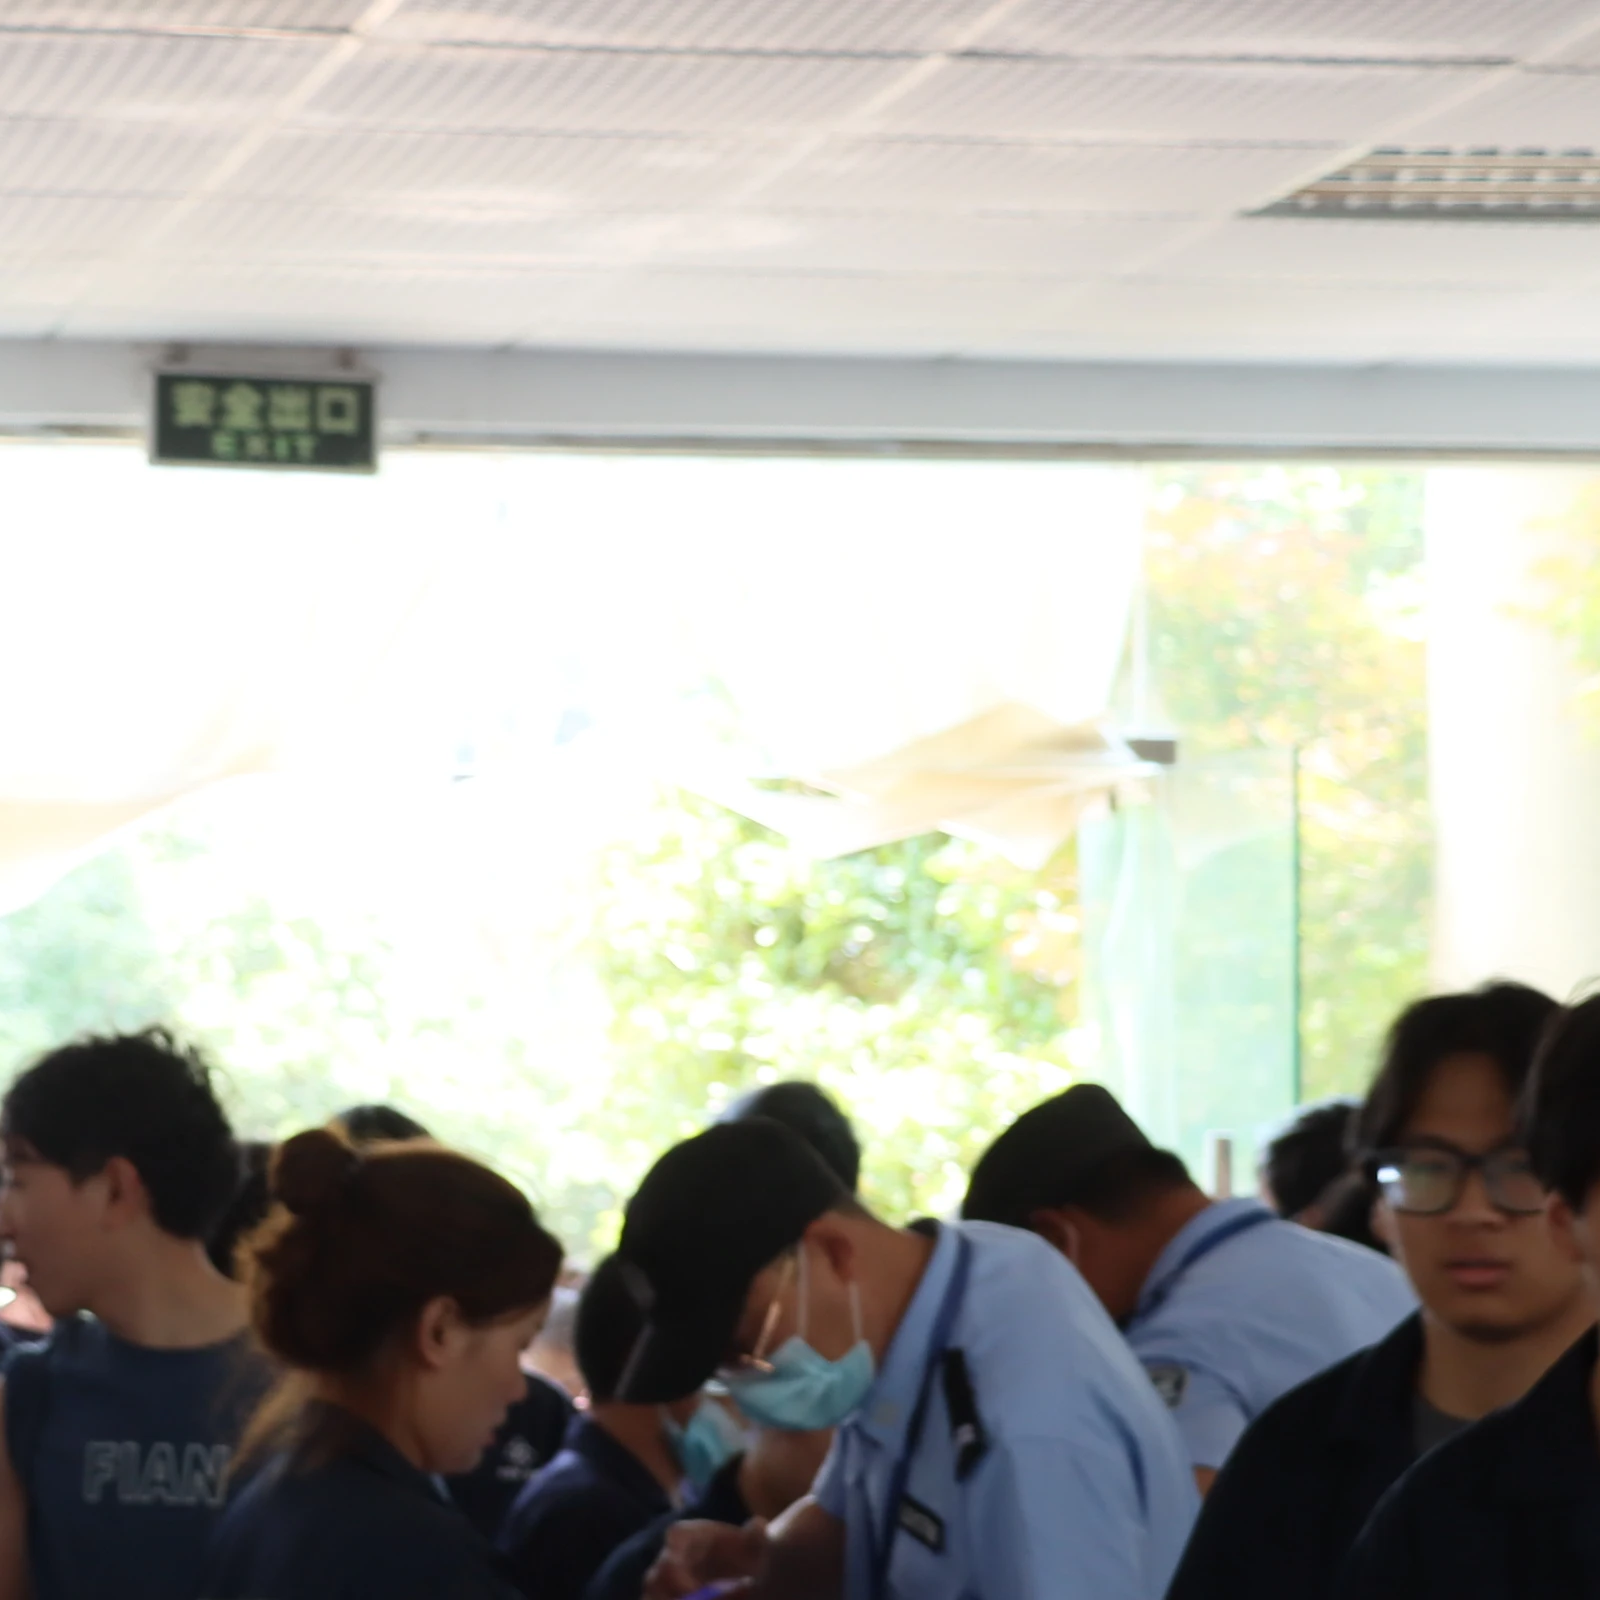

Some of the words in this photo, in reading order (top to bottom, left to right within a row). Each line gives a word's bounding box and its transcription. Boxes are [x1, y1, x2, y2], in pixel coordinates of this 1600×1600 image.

[172, 381, 359, 433] 安全出口
[212, 431, 315, 459] EXIT
